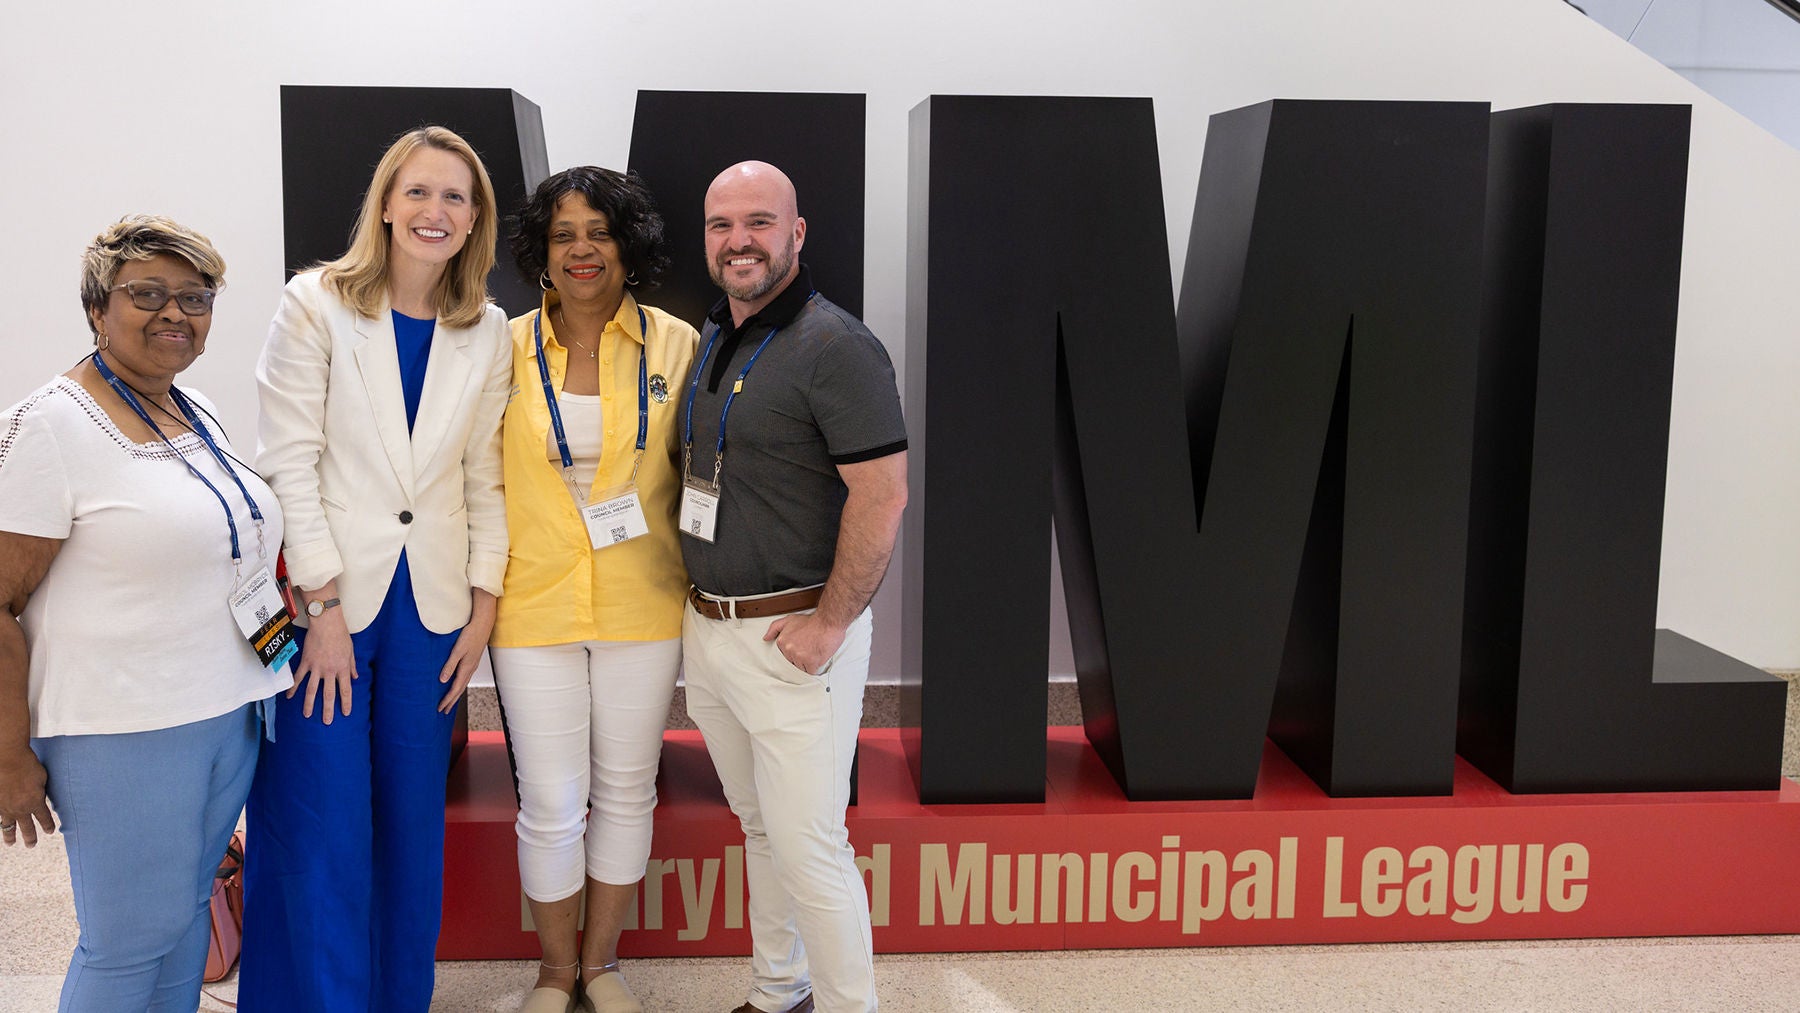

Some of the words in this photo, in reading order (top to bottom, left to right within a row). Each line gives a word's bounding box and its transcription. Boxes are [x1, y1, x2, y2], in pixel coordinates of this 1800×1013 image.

[588, 505, 607, 516] TRINA
[608, 497, 634, 510] BROWN
[590, 510, 612, 520] COUNCIL
[612, 503, 635, 513] MEMBER
[235, 592, 252, 607] COUNCIL
[251, 578, 268, 593] MEMBER
[264, 630, 290, 657] RISKY.
[521, 843, 891, 942] ryld
[918, 835, 1299, 934] Municipal
[1322, 836, 1590, 924] League
